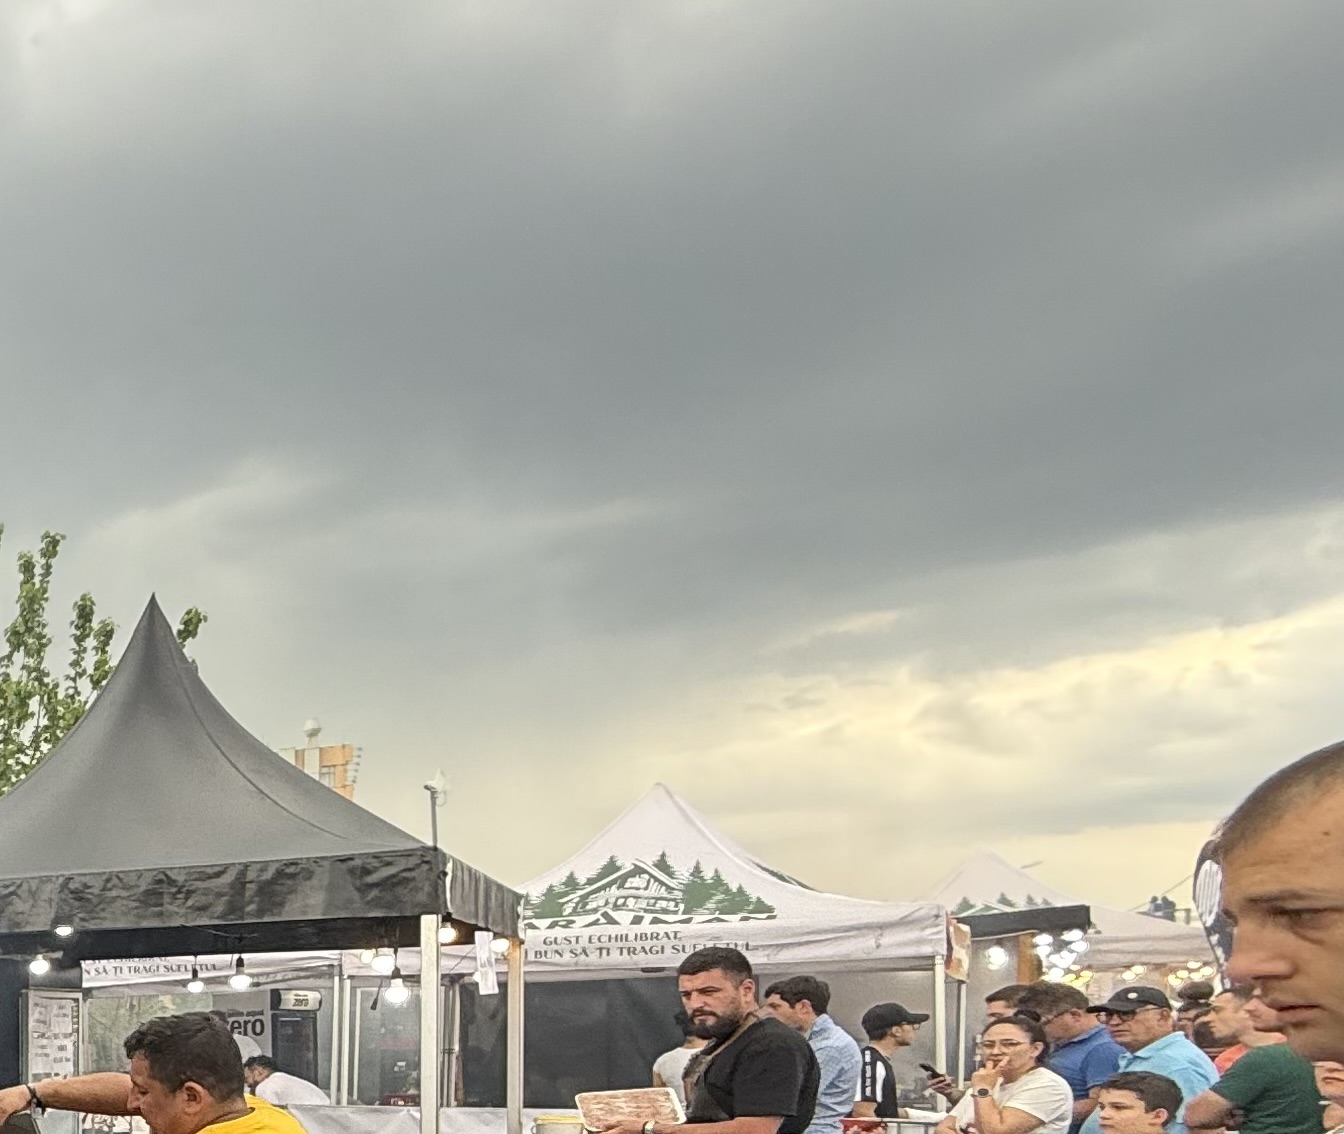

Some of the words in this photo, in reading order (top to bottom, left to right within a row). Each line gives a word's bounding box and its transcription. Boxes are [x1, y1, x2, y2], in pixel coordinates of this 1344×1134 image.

[543, 935, 583, 946] GUST
[534, 949, 564, 960] BUN
[616, 944, 665, 957] TRAGI
[227, 1017, 265, 1037] ero
